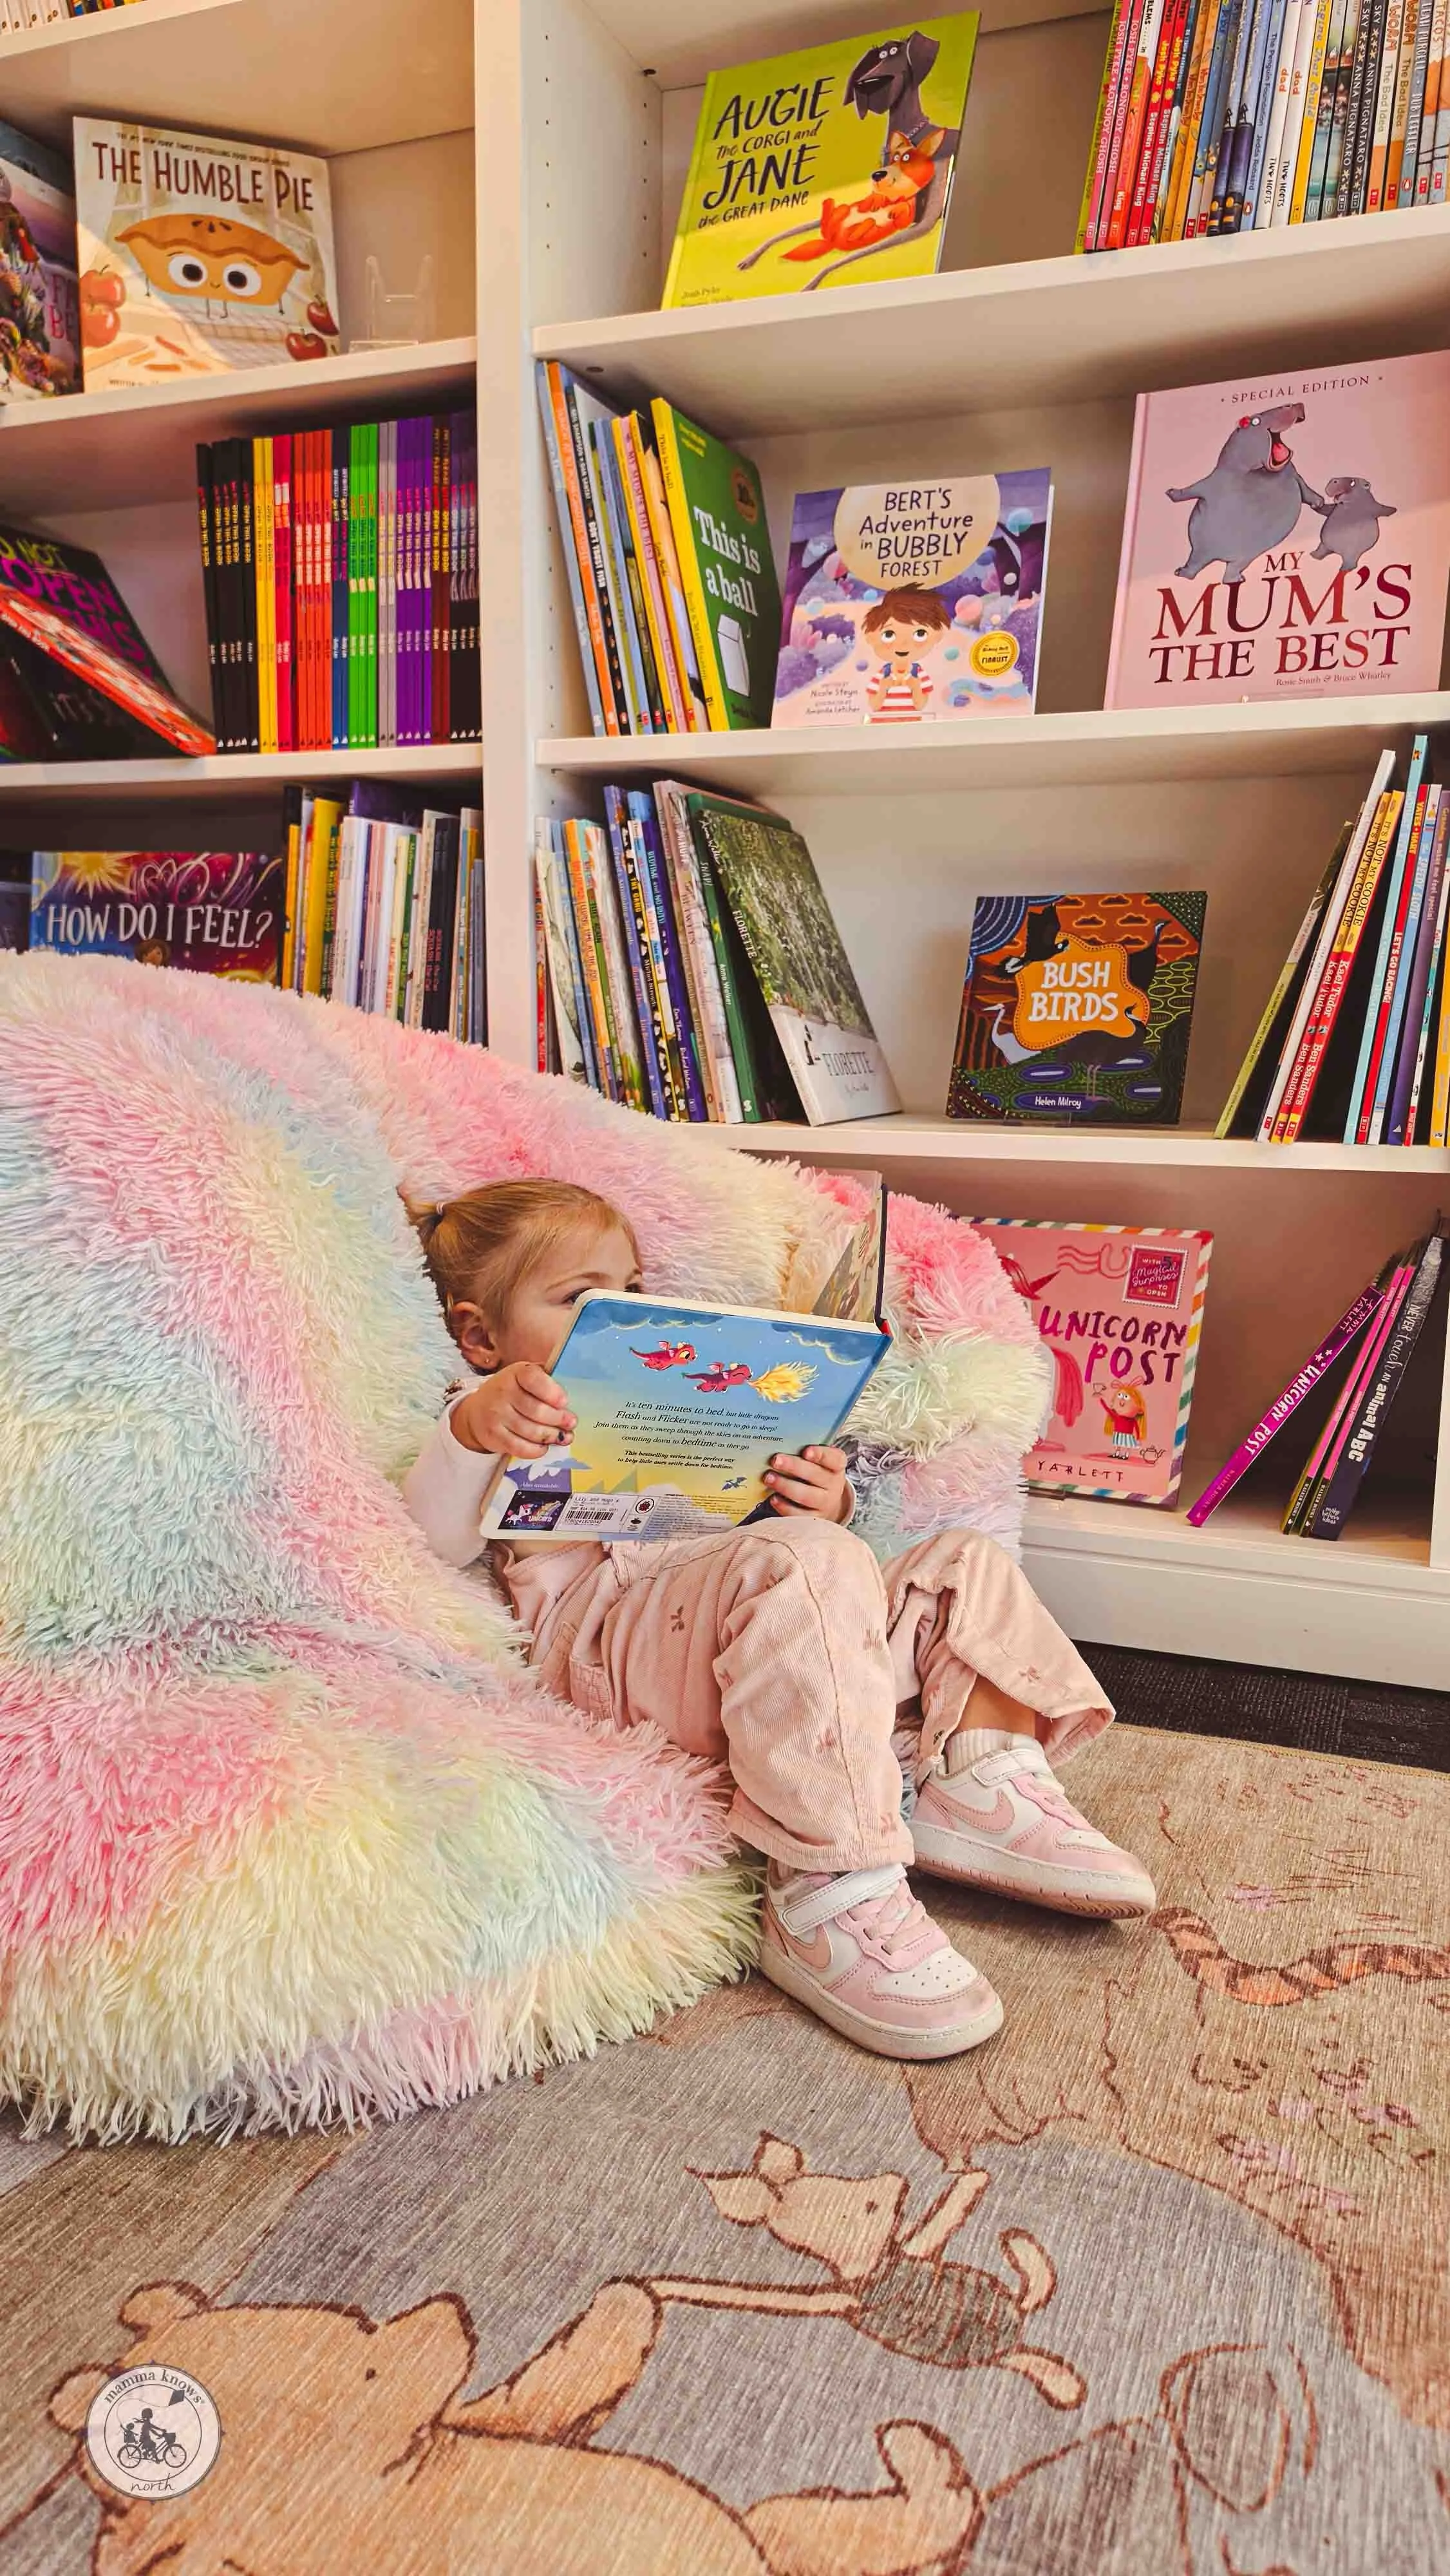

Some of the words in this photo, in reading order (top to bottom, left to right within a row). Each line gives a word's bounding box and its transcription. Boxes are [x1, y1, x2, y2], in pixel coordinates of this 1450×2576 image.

[1373, 5, 1382, 24] SKY
[1403, 0, 1418, 46] WORM
[1420, 2, 1433, 28] LEAH
[1116, 21, 1126, 44] JOSH
[1269, 33, 1277, 48] The
[1111, 49, 1122, 74] PYKE
[1415, 31, 1429, 71] PURCELL
[1265, 50, 1275, 82] Penguin
[1279, 68, 1289, 93] dad
[1364, 62, 1375, 95] ANNA
[1400, 58, 1411, 78] The
[1257, 83, 1270, 126] Foundation
[1398, 80, 1409, 102] Bad
[712, 76, 836, 141] AUGIE
[1102, 86, 1117, 134] RONOJOY
[742, 129, 790, 155] CORGI
[793, 119, 824, 149] and
[1158, 109, 1171, 144] Stephen
[1357, 99, 1371, 163] PIGNATARO
[1096, 137, 1108, 174] GHOSH
[1152, 147, 1164, 182] Michael
[92, 142, 142, 184] THE
[153, 150, 264, 204] HUMBLE
[274, 169, 314, 213] PIE
[702, 143, 822, 211] JANE
[1113, 191, 1125, 211] King
[1146, 184, 1158, 204] King
[1264, 180, 1274, 205] HOOTS
[722, 202, 766, 223] GREAT
[1230, 385, 1297, 404] SPECIAL
[1302, 375, 1371, 395] EDITION
[885, 488, 952, 511] BERT'S
[859, 511, 974, 536] Adventure
[693, 506, 741, 564] This
[741, 533, 761, 574] is
[861, 538, 873, 551] in
[877, 531, 968, 560] BUBBLY
[880, 560, 943, 578] FOREST
[1263, 551, 1305, 574] MY
[1, 556, 123, 616] OPEN
[705, 567, 719, 597] a
[716, 564, 758, 616] ball
[1151, 564, 1413, 641] MUM'S
[1148, 639, 1256, 685] THE
[1274, 626, 1411, 676] BEST
[1298, 676, 1321, 685] Smith
[1333, 673, 1357, 683] Bruce
[1413, 801, 1425, 827] YATES
[1373, 841, 1388, 866] NOT
[1409, 833, 1420, 855] HART
[1435, 842, 1444, 866] makes
[1368, 866, 1379, 880] MY
[1431, 879, 1440, 896] feel
[1353, 880, 1374, 927] COOKIE
[1426, 896, 1437, 921] special
[46, 903, 111, 946] HOW
[118, 903, 158, 942] DO
[165, 903, 175, 942] I
[185, 904, 274, 949] FEEL?
[732, 910, 758, 960] FLORETTE
[1391, 931, 1402, 955] LET'S
[1040, 960, 1111, 989] BUSH
[1333, 959, 1350, 987] Kael
[1389, 956, 1398, 969] GO
[724, 981, 732, 1005] Walker
[1382, 969, 1397, 1004] RACING!
[1028, 991, 1119, 1022] BIRDS
[1323, 985, 1341, 1019] Tudor
[1308, 1041, 1324, 1064] Ben
[1295, 1064, 1315, 1106] Sanders
[1035, 1095, 1057, 1107] Helen
[1057, 1095, 1082, 1110] Milroy
[1161, 1256, 1172, 1269] 5
[1039, 1305, 1187, 1350] UNICORN
[1339, 1296, 1368, 1331] YARLETT
[1346, 1298, 1374, 1334] EMMA
[1400, 1303, 1422, 1332] NEVER
[1084, 1341, 1180, 1387] POST
[1384, 1333, 1412, 1372] touch
[1381, 1371, 1392, 1383] AN
[1271, 1363, 1321, 1423] UNICORN
[1361, 1383, 1388, 1428] animal
[615, 1410, 641, 1420] Flash
[657, 1414, 690, 1425] Flicker
[714, 1420, 733, 1429] ready
[655, 1403, 692, 1414] minutes
[593, 1421, 610, 1429] Join
[639, 1424, 655, 1433] they
[677, 1428, 703, 1437] through
[621, 1435, 652, 1444] counting
[681, 1437, 717, 1448] bedtime
[1243, 1421, 1272, 1455] POST
[639, 1450, 669, 1459] bestselling
[1348, 1427, 1374, 1463] ABC
[1037, 1460, 1124, 1482] YARLETT
